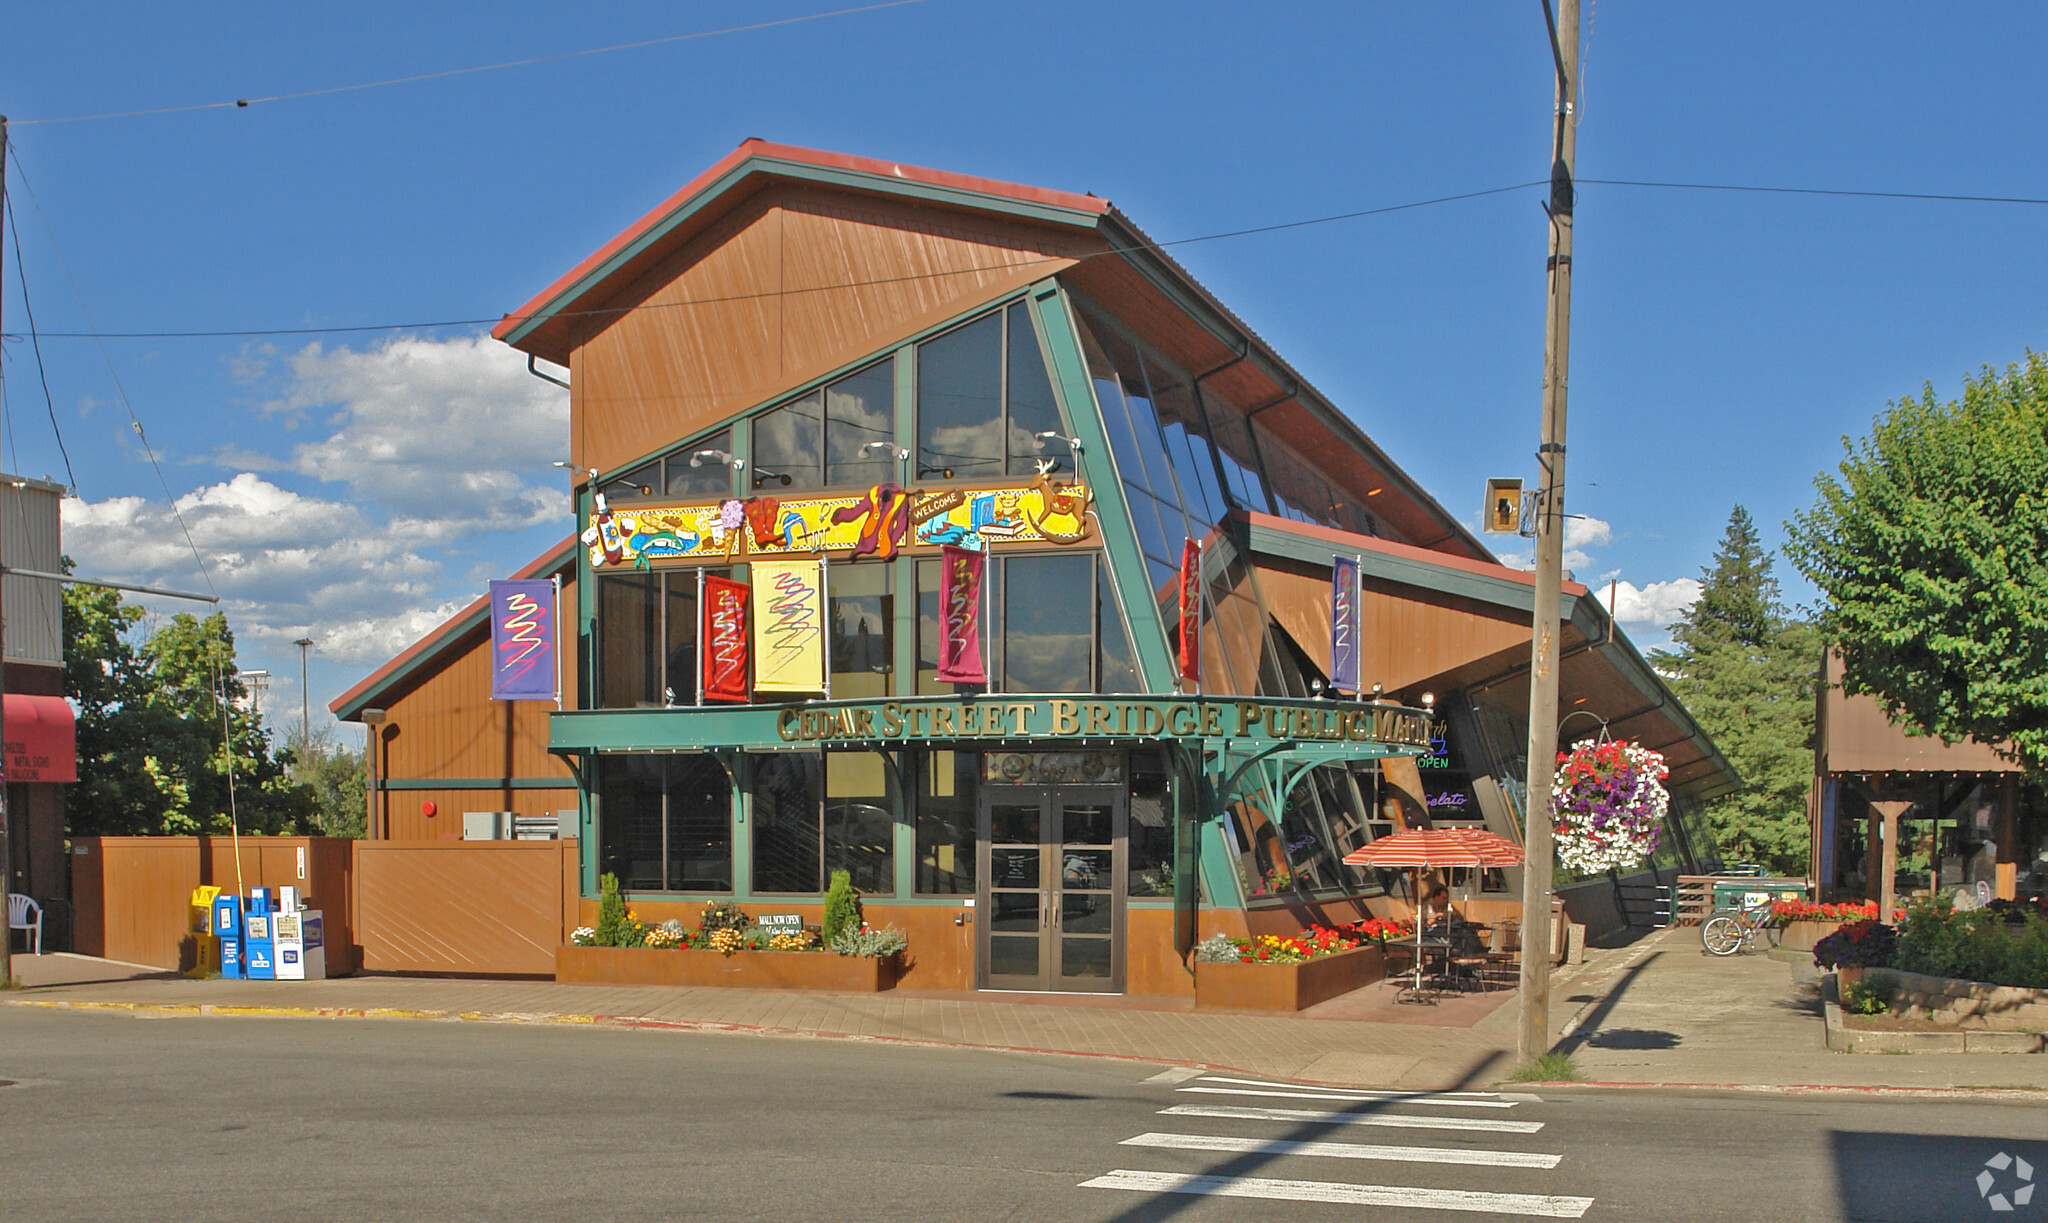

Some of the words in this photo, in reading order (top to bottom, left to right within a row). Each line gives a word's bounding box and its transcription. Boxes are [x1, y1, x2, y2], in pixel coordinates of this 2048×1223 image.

[913, 492, 957, 519] WELCOME
[776, 707, 876, 741] CEDAR
[882, 702, 1036, 738] STREET
[1049, 699, 1223, 736] BRIDGE
[1235, 702, 1367, 741] PUBLIC
[1417, 757, 1449, 769] OPEN
[1424, 791, 1468, 807] Gelato
[786, 915, 799, 925] OPEN
